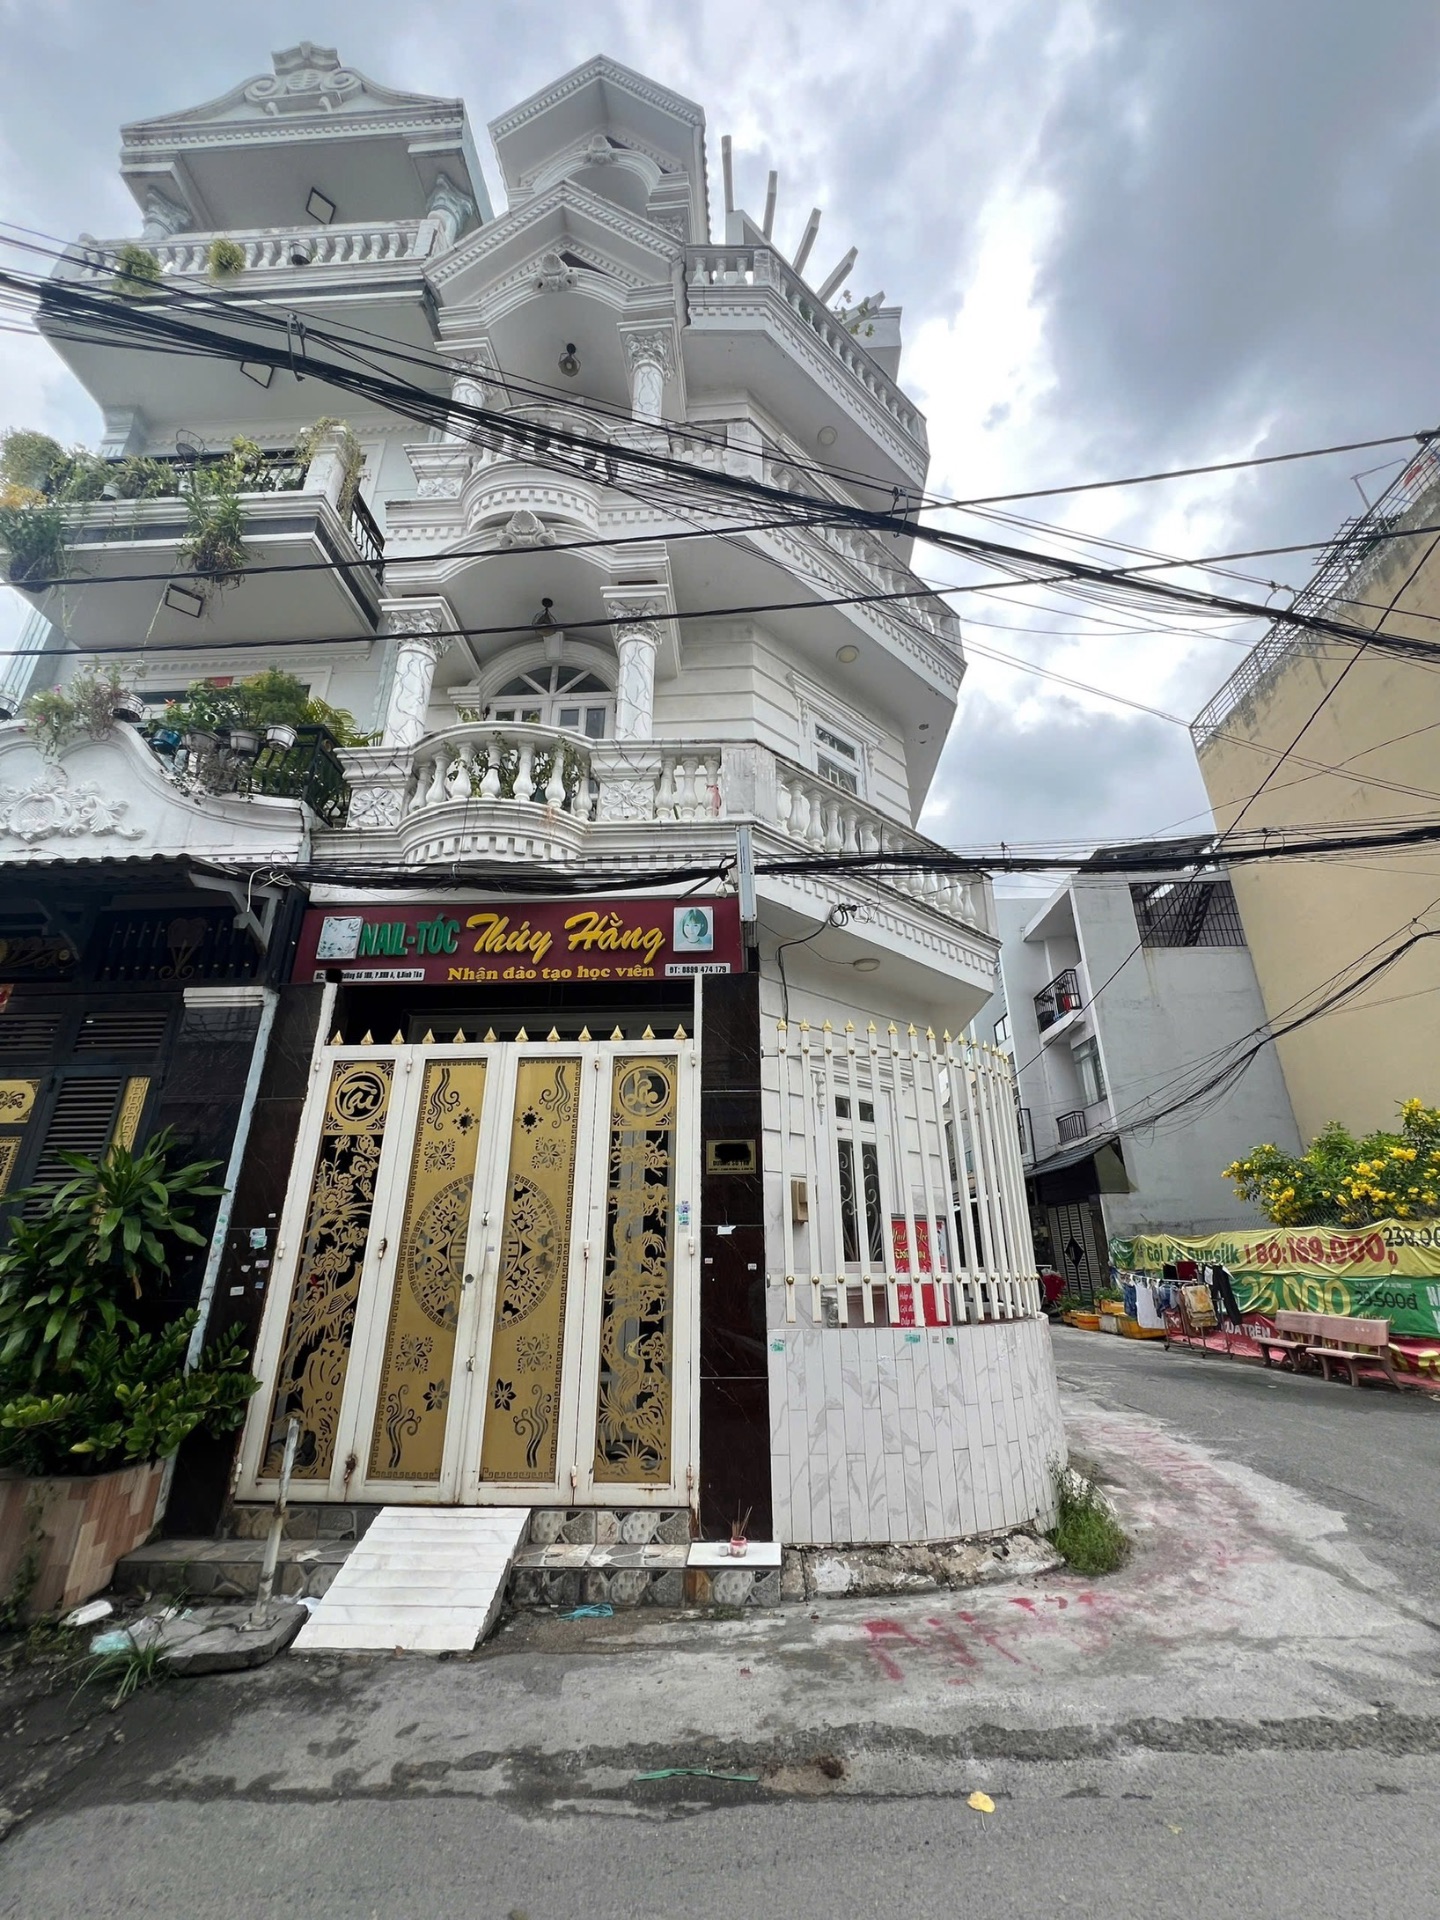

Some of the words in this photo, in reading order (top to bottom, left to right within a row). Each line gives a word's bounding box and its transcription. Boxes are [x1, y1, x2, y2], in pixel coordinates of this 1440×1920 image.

[466, 913, 553, 965] Thúy
[564, 911, 666, 965] Hằng
[447, 967, 499, 983] Nhận
[502, 965, 537, 980] đào
[542, 966, 573, 982] tạo
[577, 965, 611, 981] học
